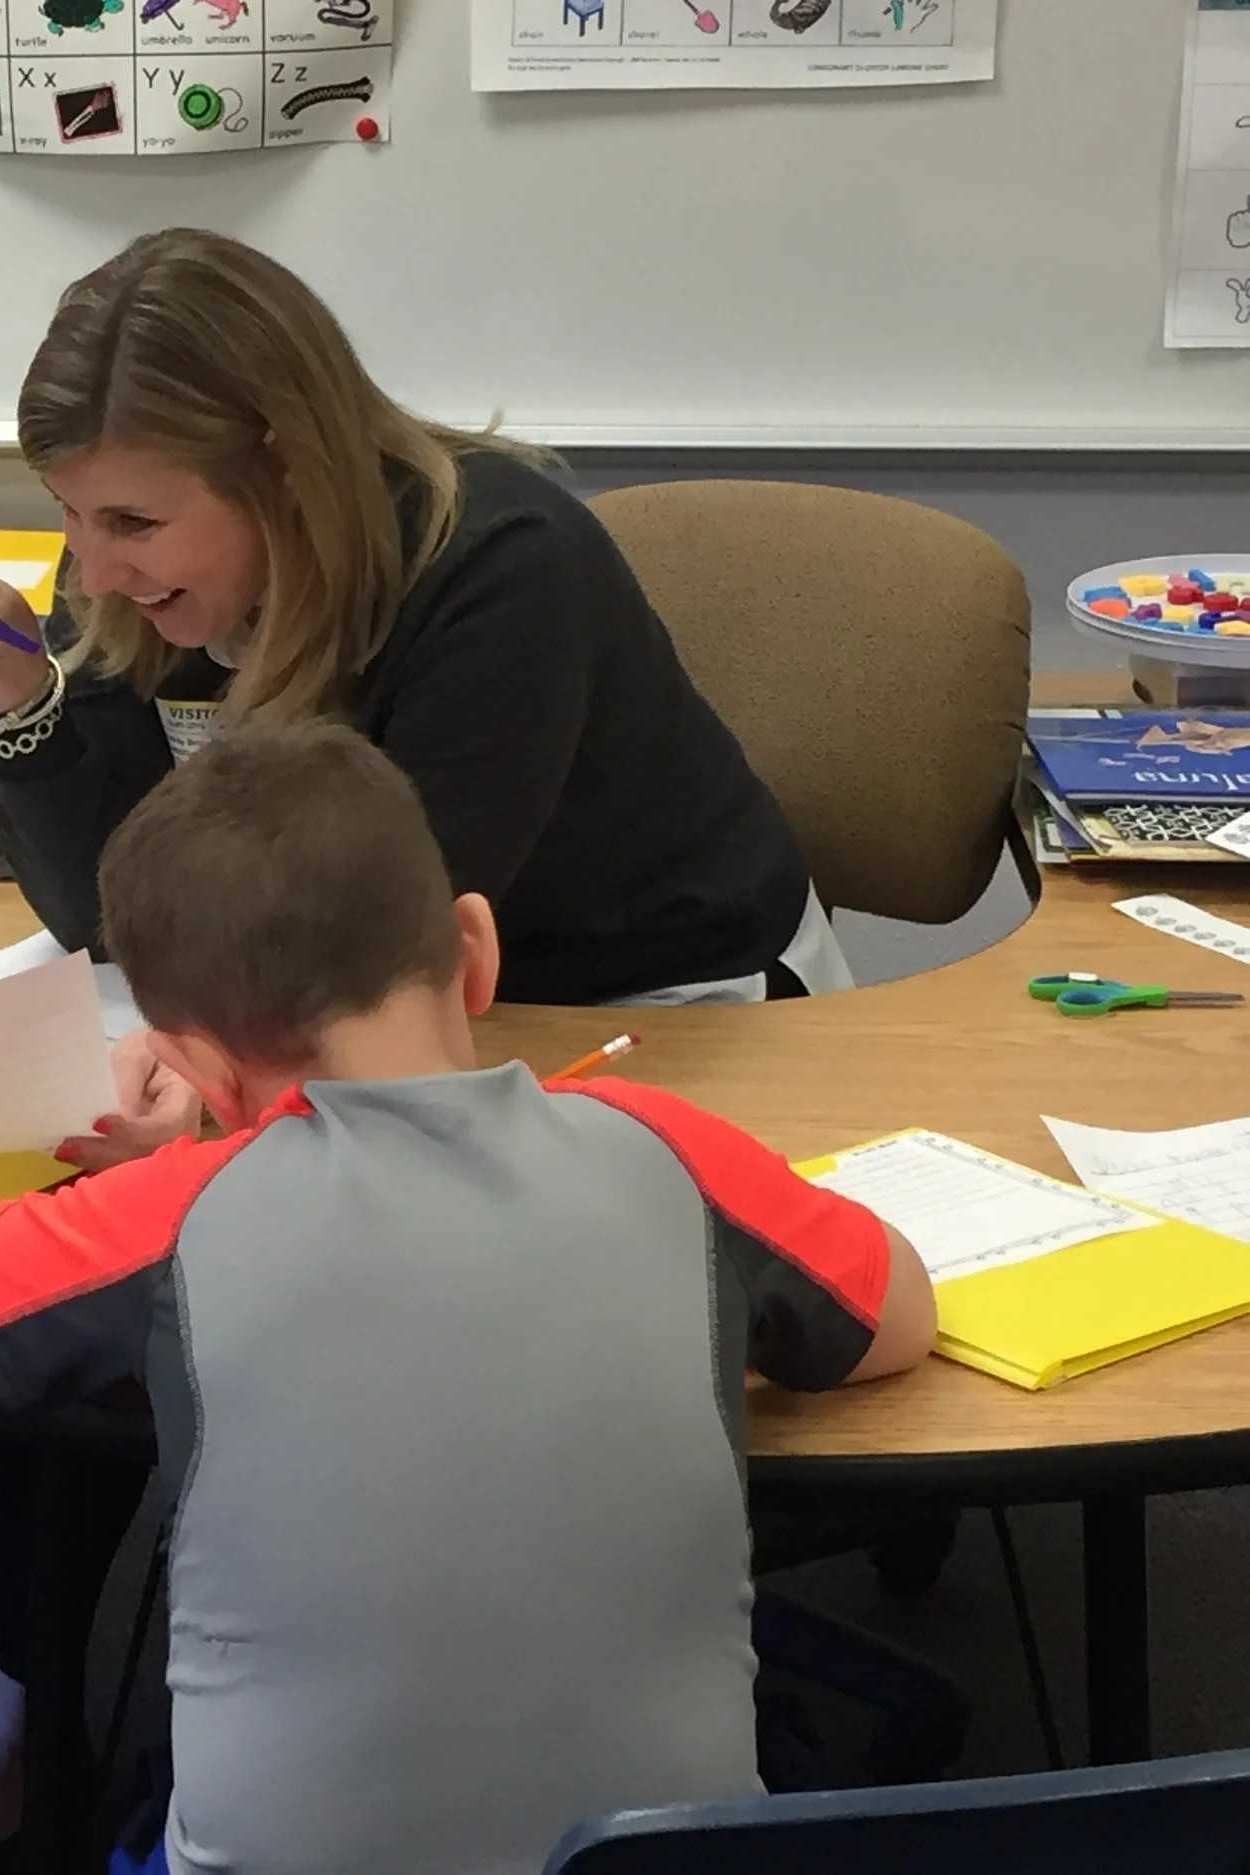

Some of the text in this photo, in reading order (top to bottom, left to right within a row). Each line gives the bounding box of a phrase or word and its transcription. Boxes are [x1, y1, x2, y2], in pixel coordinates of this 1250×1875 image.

[15, 36, 48, 47] turtle
[141, 34, 251, 46] umbrella unicorn
[18, 67, 57, 88] X x
[142, 67, 185, 96] Y y
[270, 62, 308, 84] Z z
